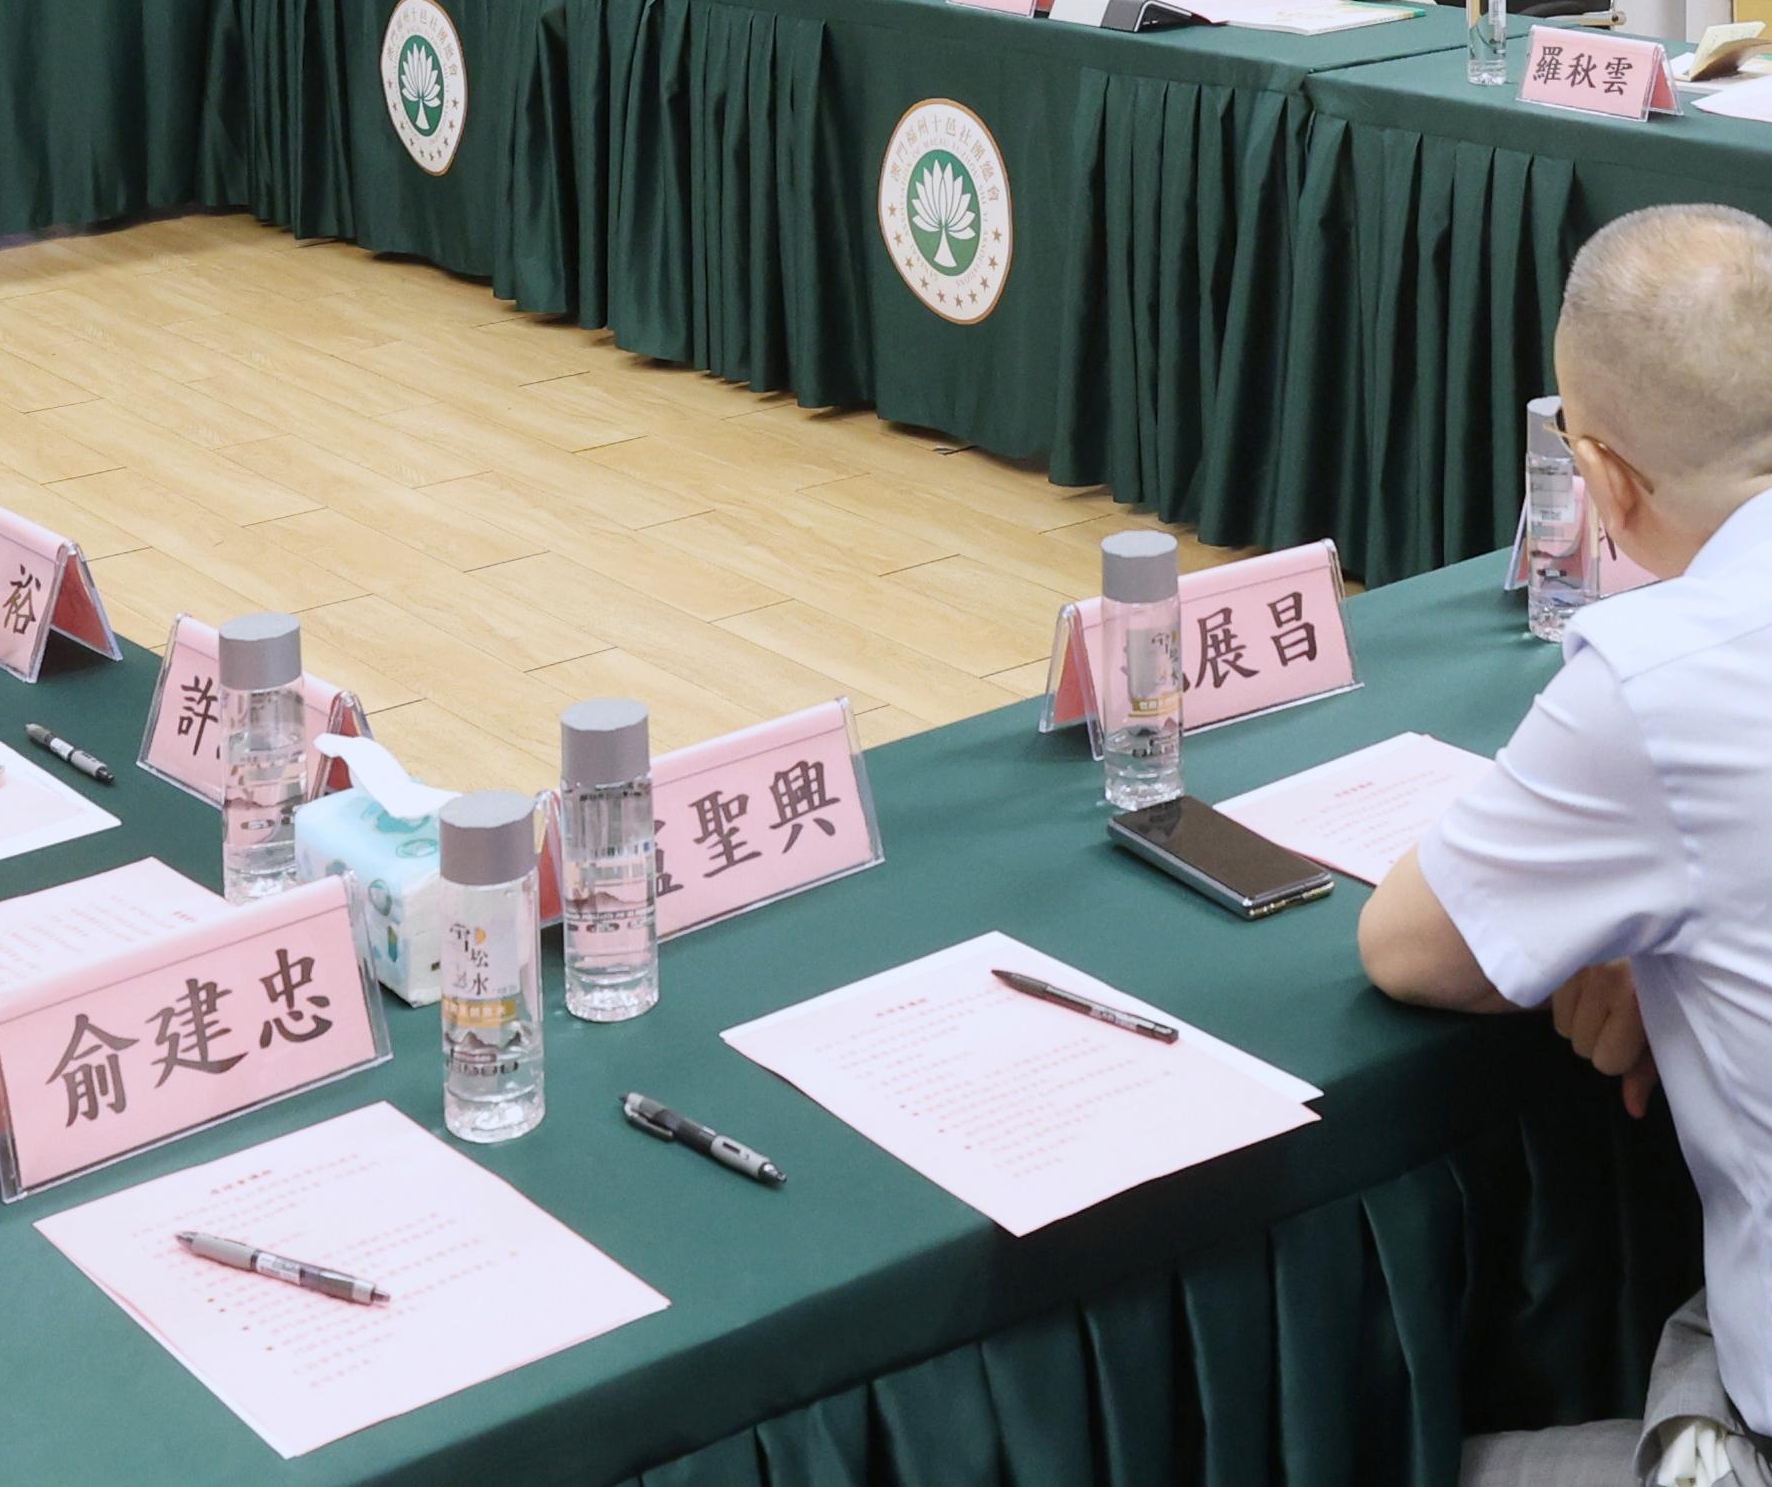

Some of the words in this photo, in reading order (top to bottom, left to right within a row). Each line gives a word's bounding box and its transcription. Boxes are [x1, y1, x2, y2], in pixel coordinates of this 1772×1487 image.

[1533, 46, 1633, 95] 羅秋雲
[1180, 590, 1318, 693] 展昌
[46, 946, 334, 1129] 俞建忠
